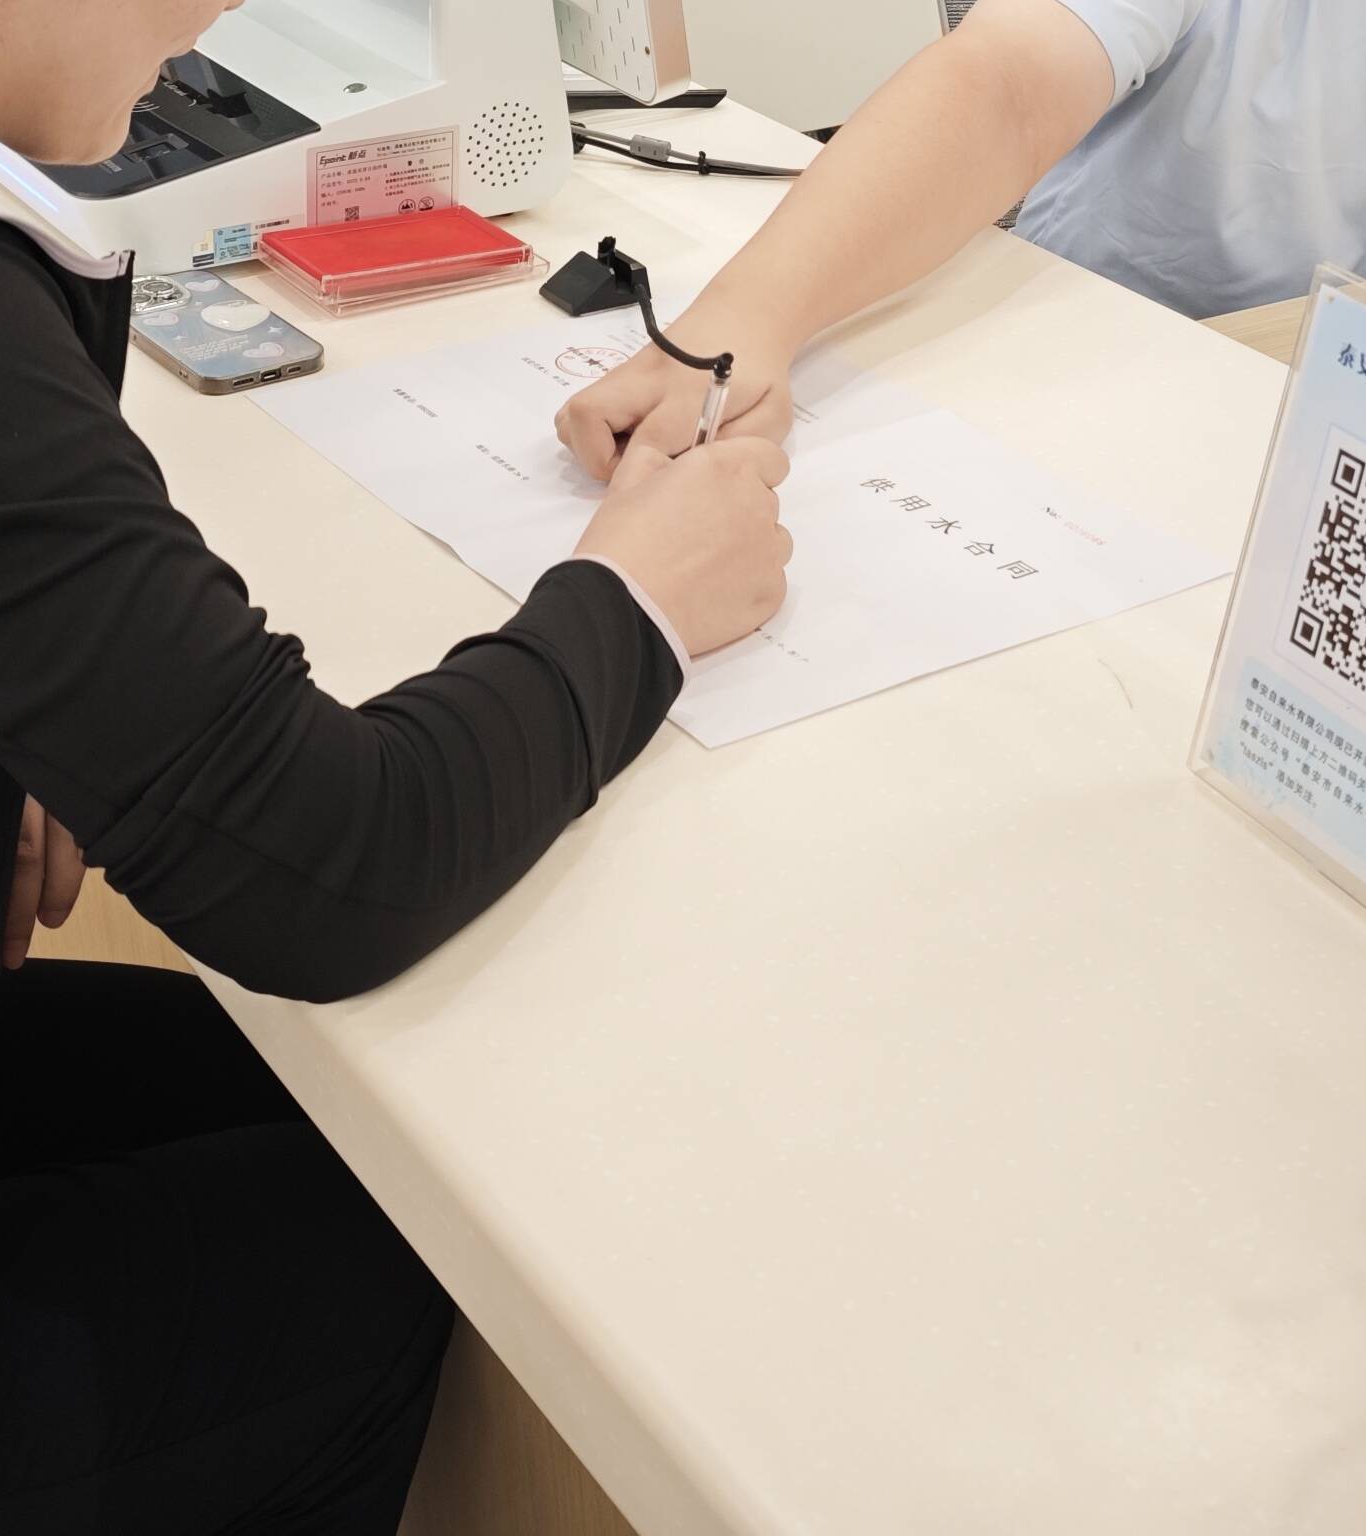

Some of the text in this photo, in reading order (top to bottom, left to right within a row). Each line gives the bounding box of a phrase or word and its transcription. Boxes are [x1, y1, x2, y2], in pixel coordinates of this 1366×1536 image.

[319, 152, 347, 167] Epoint
[859, 476, 1040, 580] 供用水合同
